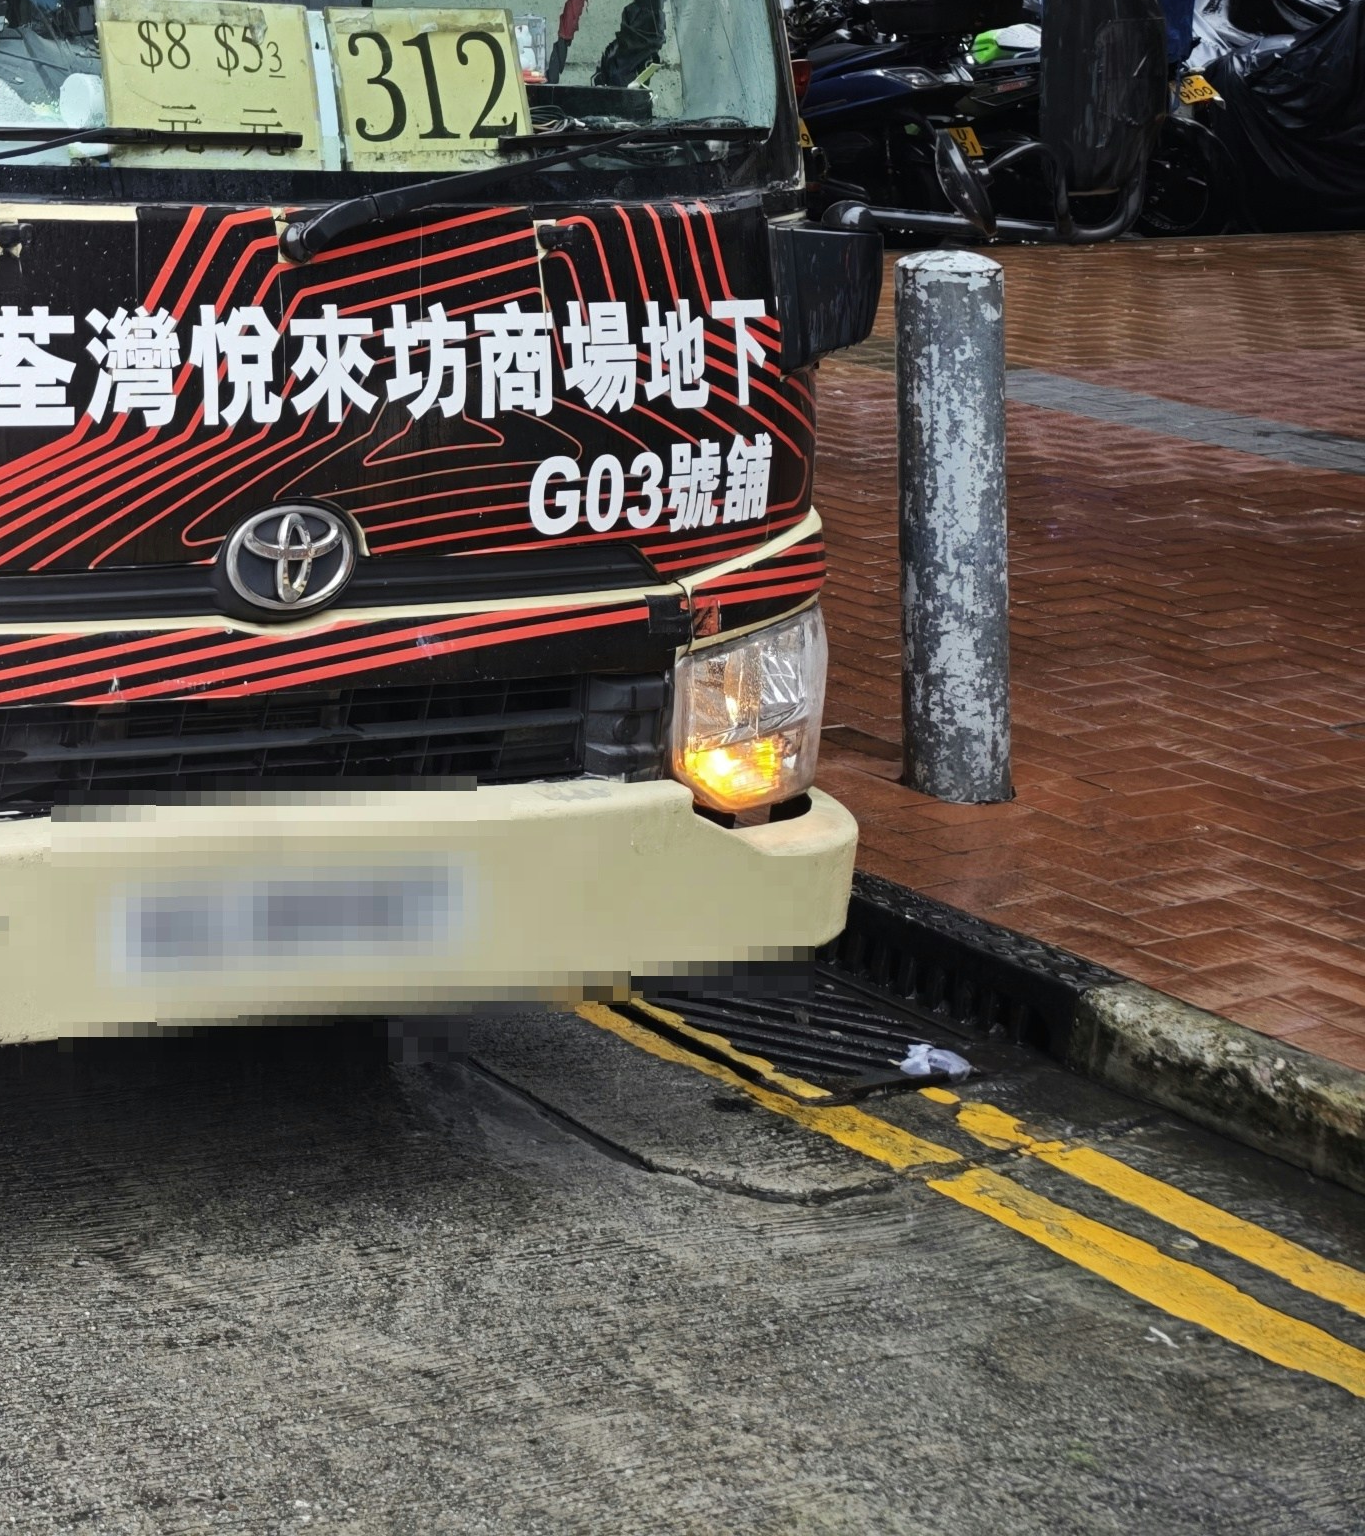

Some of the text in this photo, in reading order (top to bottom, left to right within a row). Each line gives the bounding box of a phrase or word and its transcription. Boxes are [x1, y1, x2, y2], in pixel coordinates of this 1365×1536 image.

[137, 19, 192, 74] $8
[347, 31, 518, 142] 312
[529, 433, 773, 536] G03號舖
